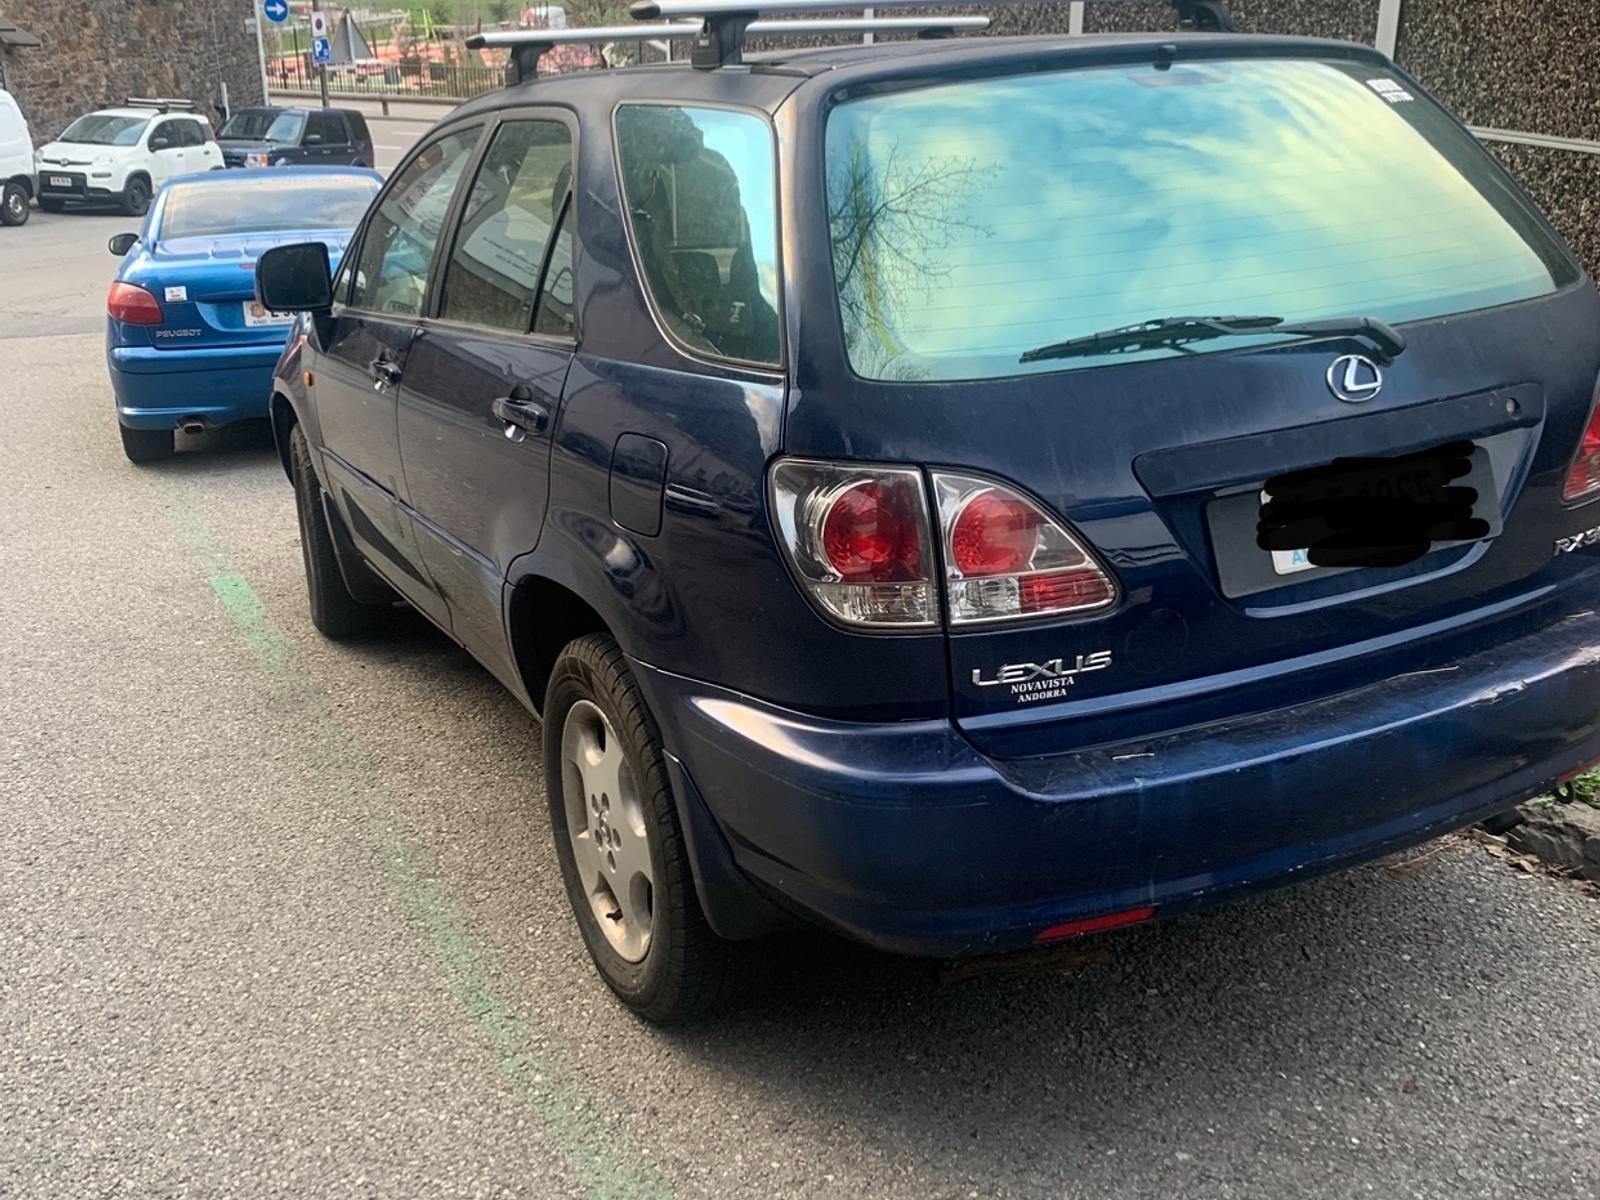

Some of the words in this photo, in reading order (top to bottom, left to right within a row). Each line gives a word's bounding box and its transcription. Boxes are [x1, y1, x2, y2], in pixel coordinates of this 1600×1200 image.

[315, 40, 323, 57] P
[155, 329, 202, 338] PEUGEOT
[1553, 526, 1600, 556] RX3
[972, 650, 1112, 686] LEXUS
[1011, 676, 1075, 694] NOVAVISTA
[1017, 688, 1067, 703] ANDORRA
